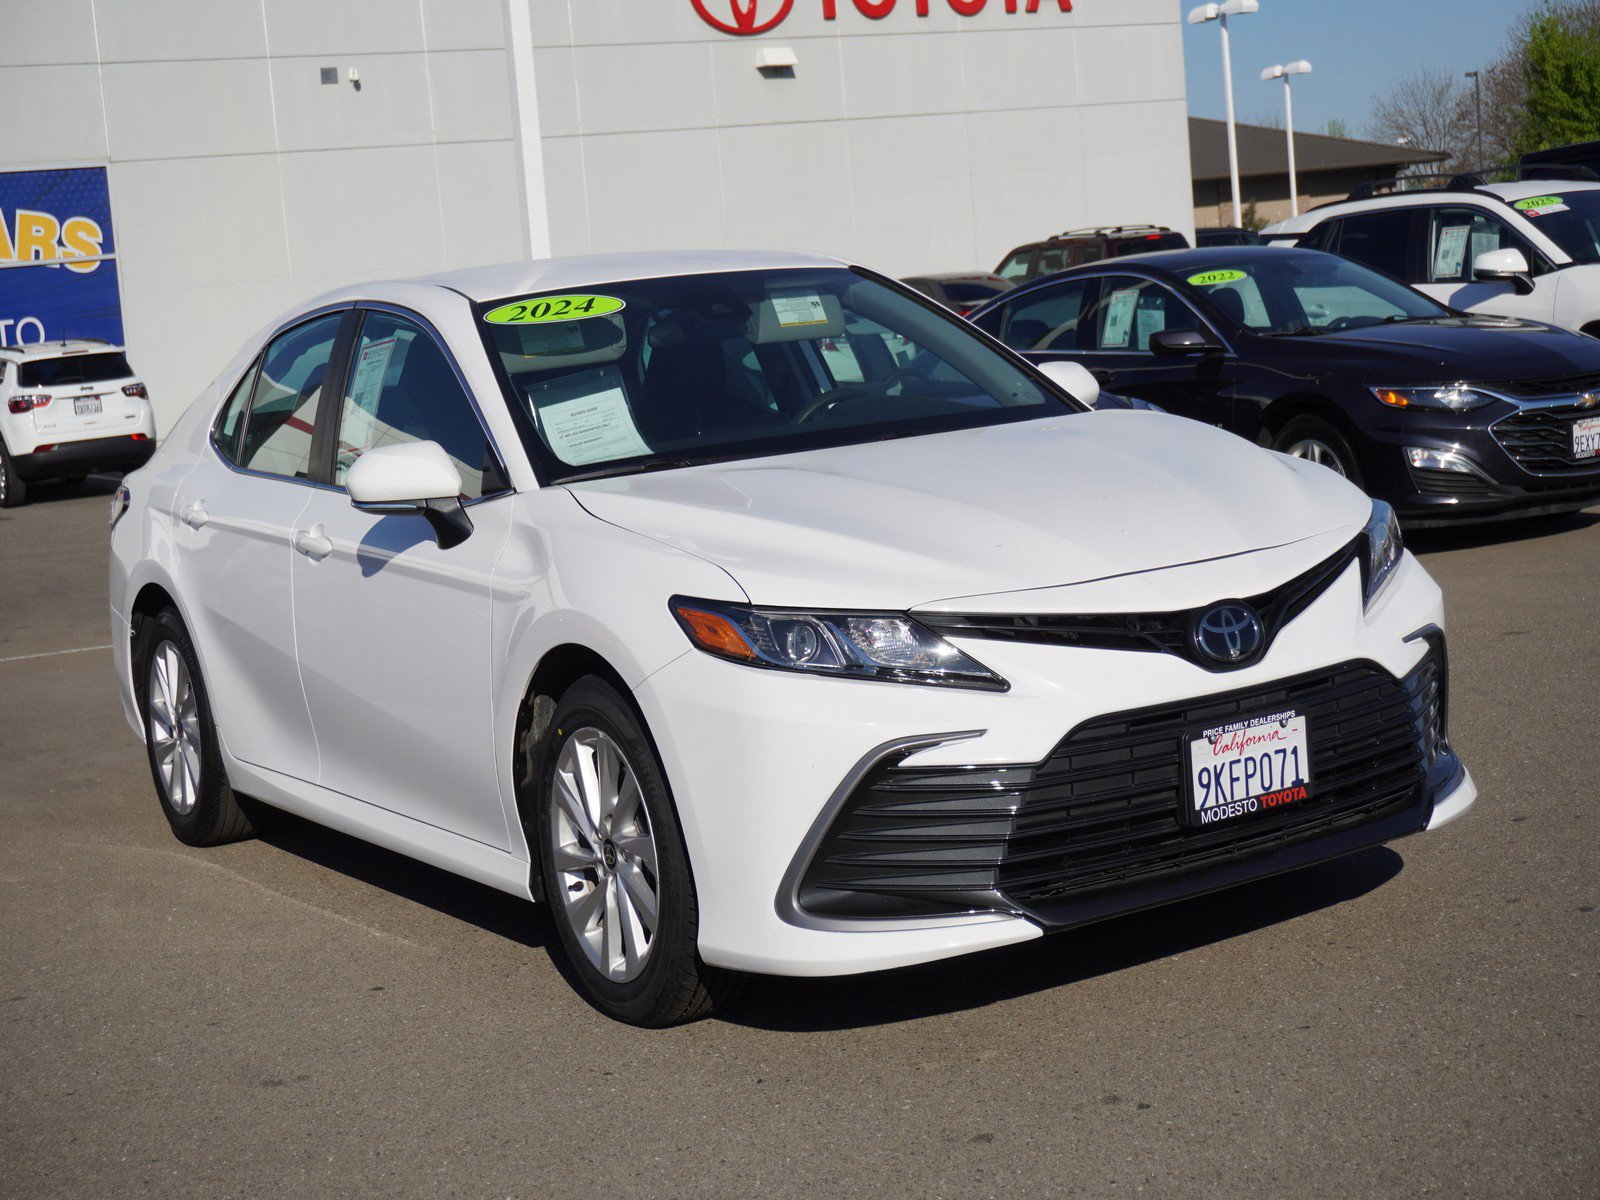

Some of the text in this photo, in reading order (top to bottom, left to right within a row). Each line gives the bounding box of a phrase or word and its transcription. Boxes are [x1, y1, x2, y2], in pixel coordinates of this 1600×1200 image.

[1523, 198, 1554, 209] 2025
[1200, 272, 1235, 283] 2022
[506, 297, 596, 322] 2024
[579, 425, 601, 434] WARRANTIES
[583, 436, 603, 445] WARRANTY
[1203, 710, 1296, 738] PRICE FAMILY DEALERSHIPS
[1213, 727, 1287, 756] California
[1198, 745, 1305, 809] 9KFP071
[1201, 786, 1308, 824] MODESTO TOYOTA
